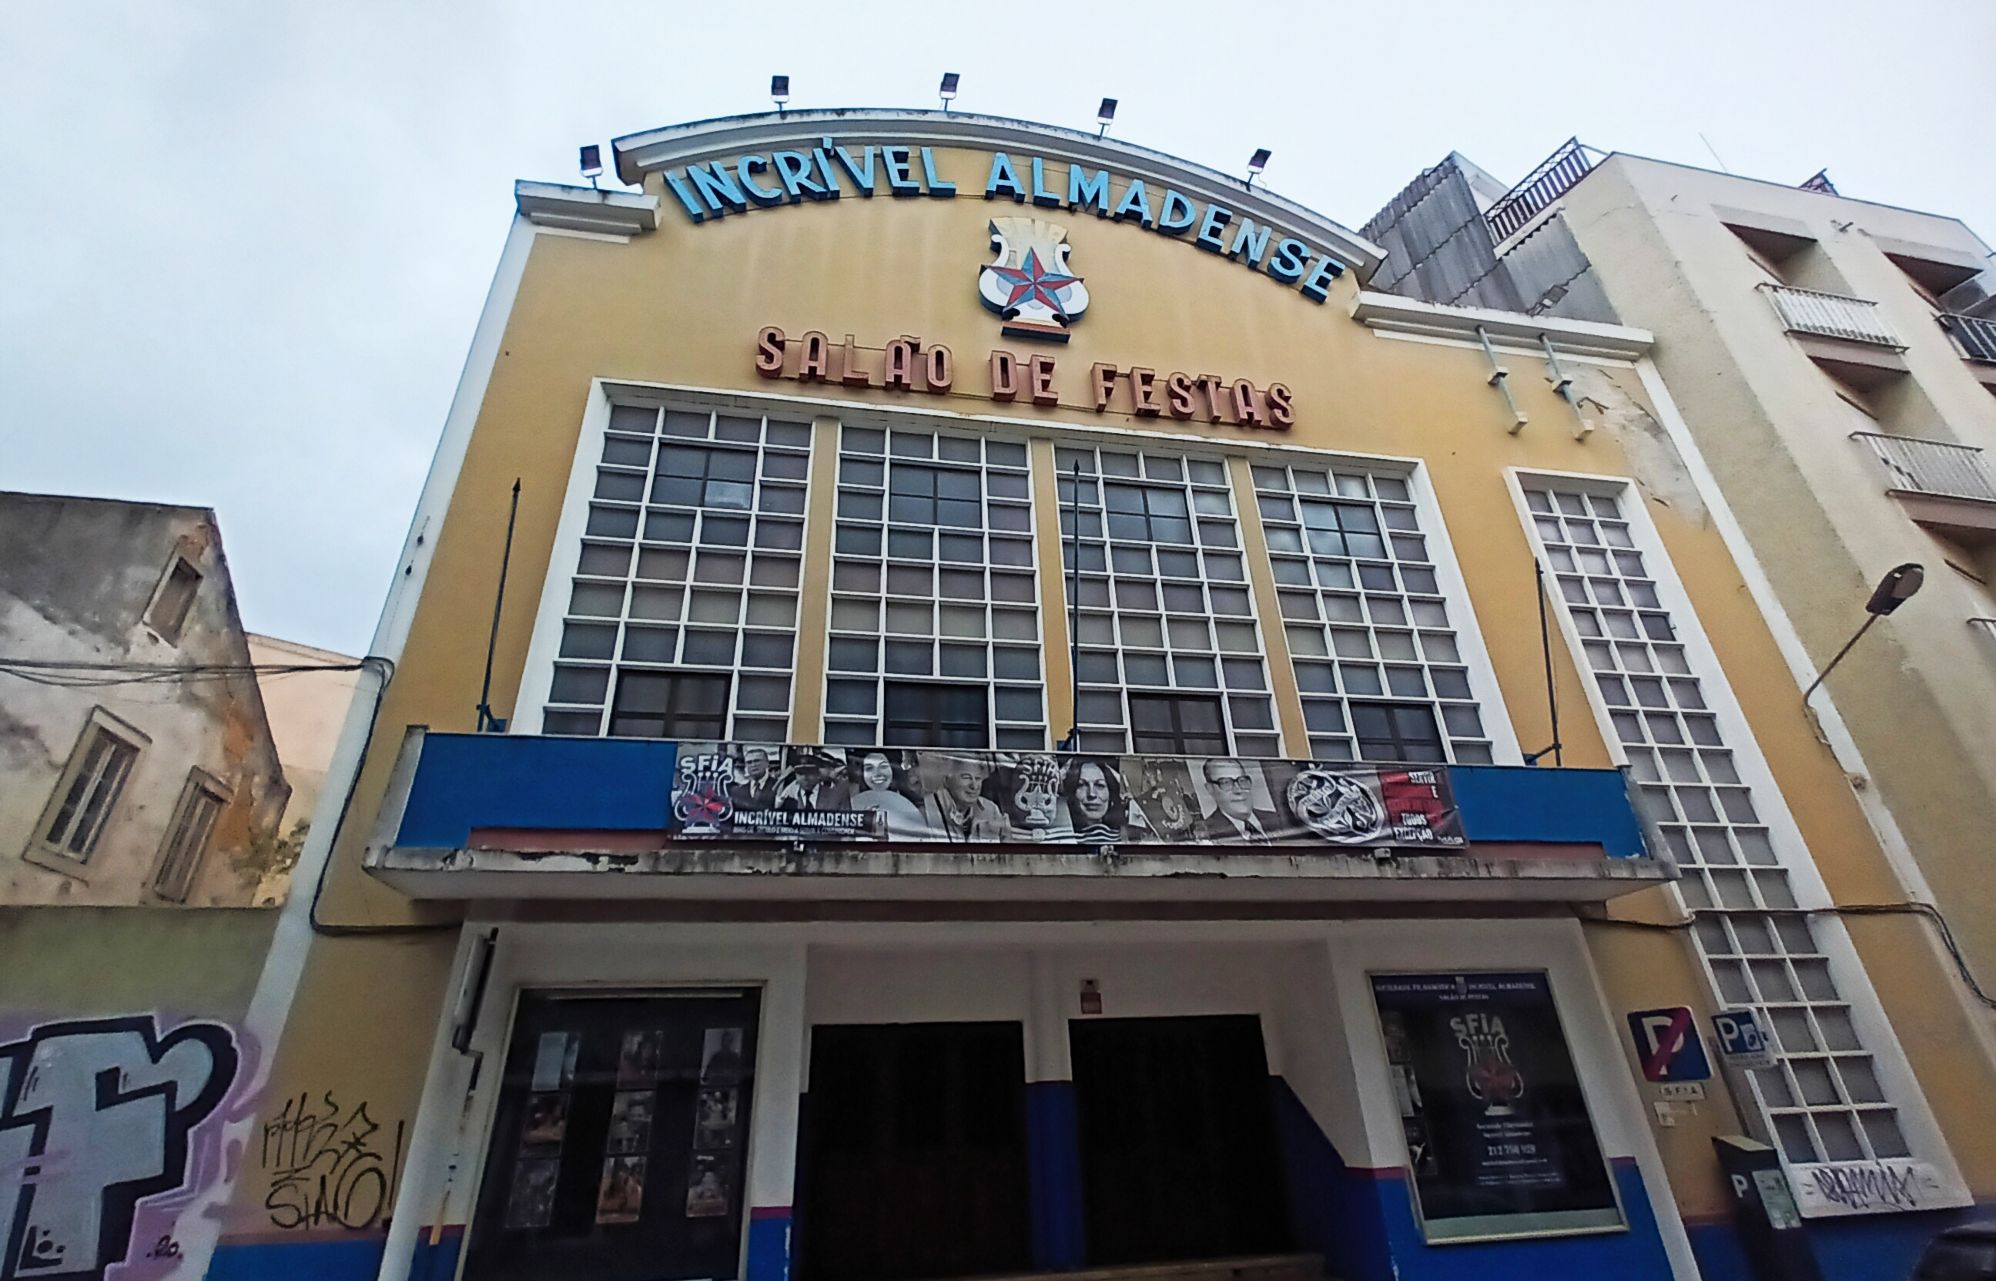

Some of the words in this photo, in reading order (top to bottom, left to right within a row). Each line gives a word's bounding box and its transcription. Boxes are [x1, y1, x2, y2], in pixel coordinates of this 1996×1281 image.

[663, 136, 956, 223] INCRÍVEL
[985, 152, 1345, 304] ALMADENSE
[756, 326, 952, 395] SALÃO
[990, 350, 1058, 406] DE
[1091, 362, 1295, 430] FESTAS
[734, 808, 790, 826] INCRÍVEL
[792, 810, 864, 827] ALMADENSE
[1715, 1017, 1740, 1052] P
[1731, 1174, 1749, 1198] P
